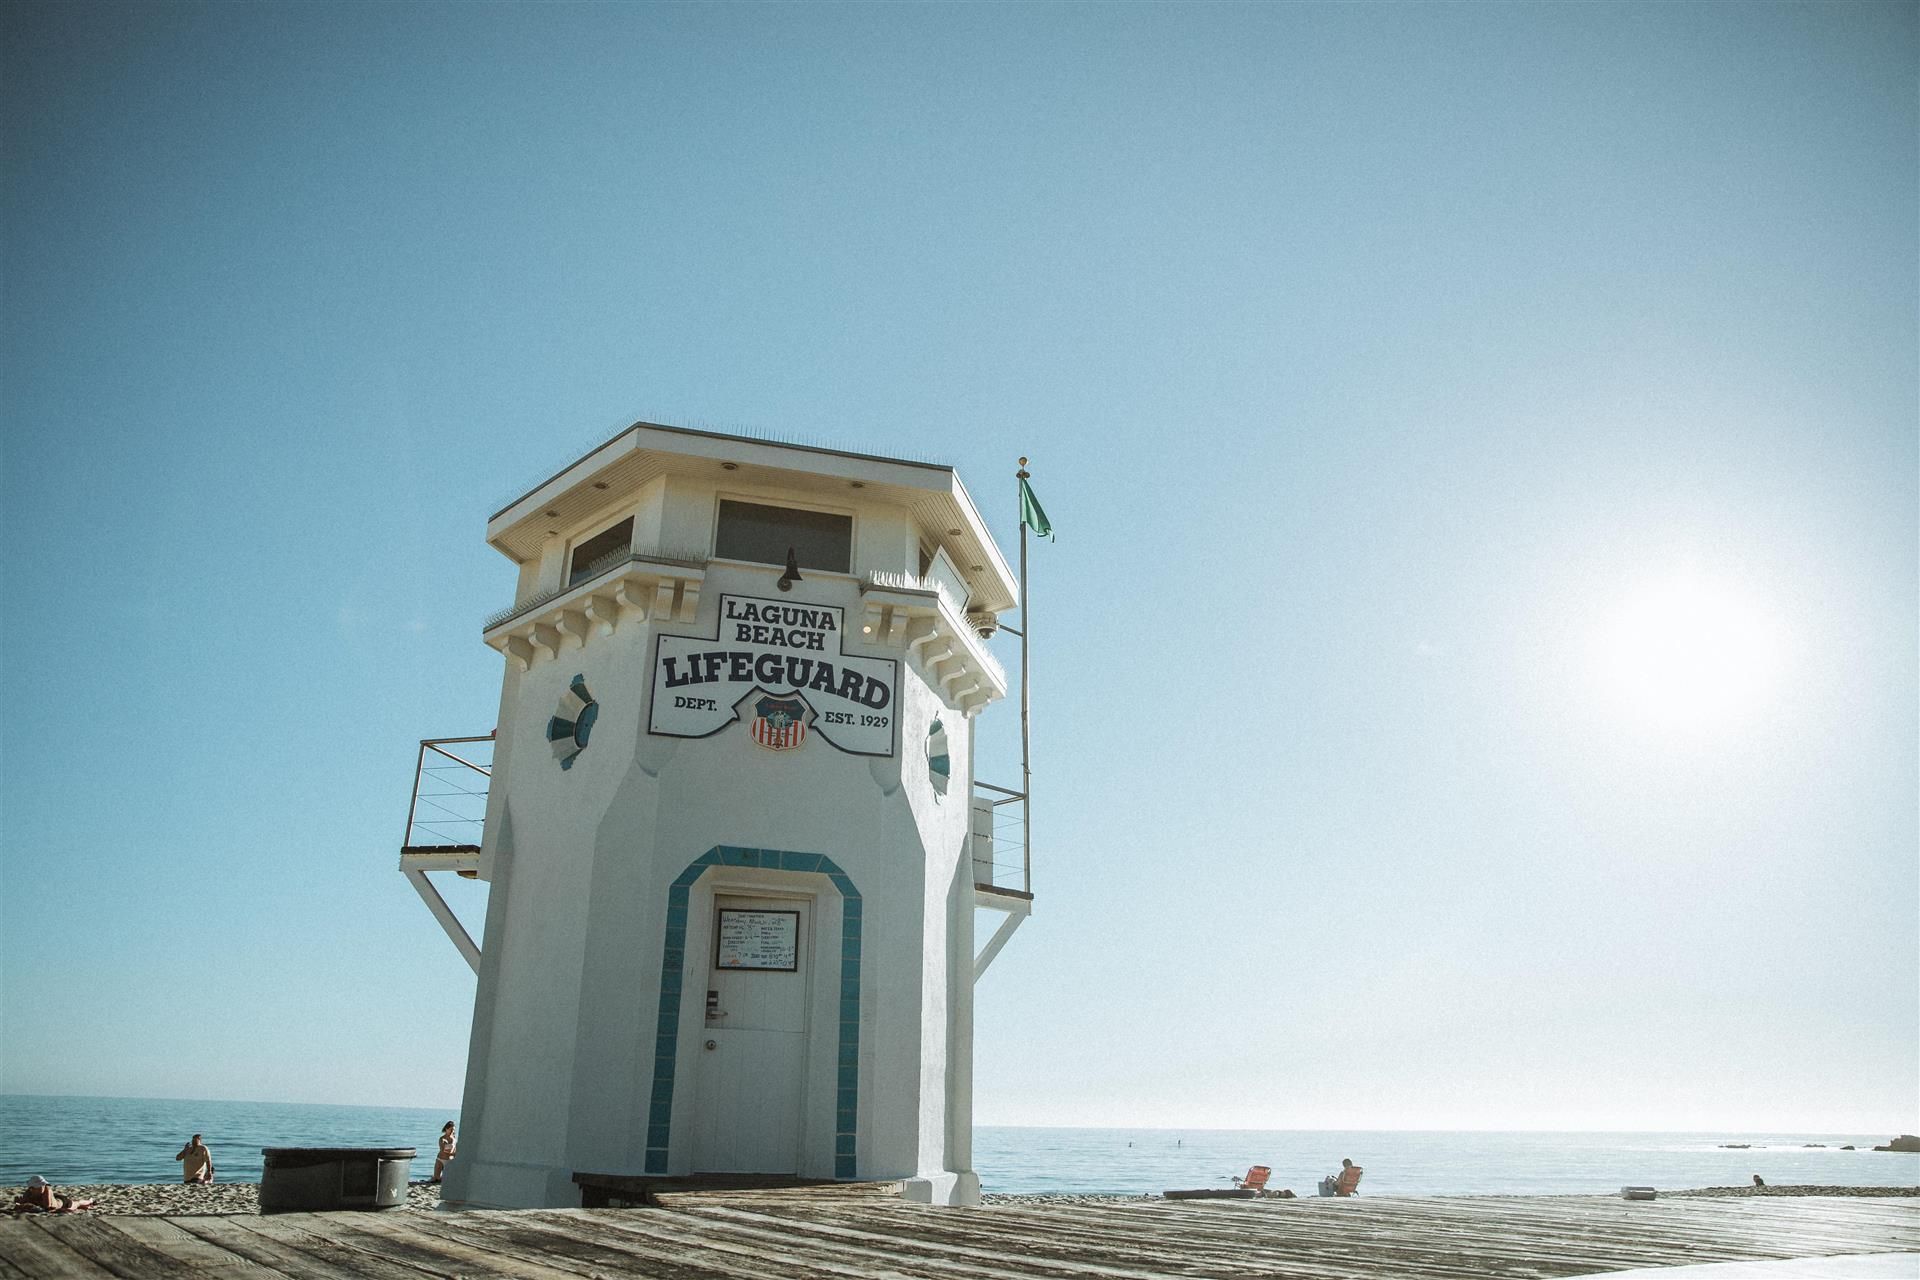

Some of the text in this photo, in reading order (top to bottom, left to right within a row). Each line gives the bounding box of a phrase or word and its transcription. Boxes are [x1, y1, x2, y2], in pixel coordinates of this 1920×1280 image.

[726, 600, 837, 631] LAGUNA
[736, 623, 826, 651] BEACH
[663, 652, 891, 710] LIFEGUARD
[674, 696, 718, 712] DEPT.
[824, 711, 889, 728] EST. 1929
